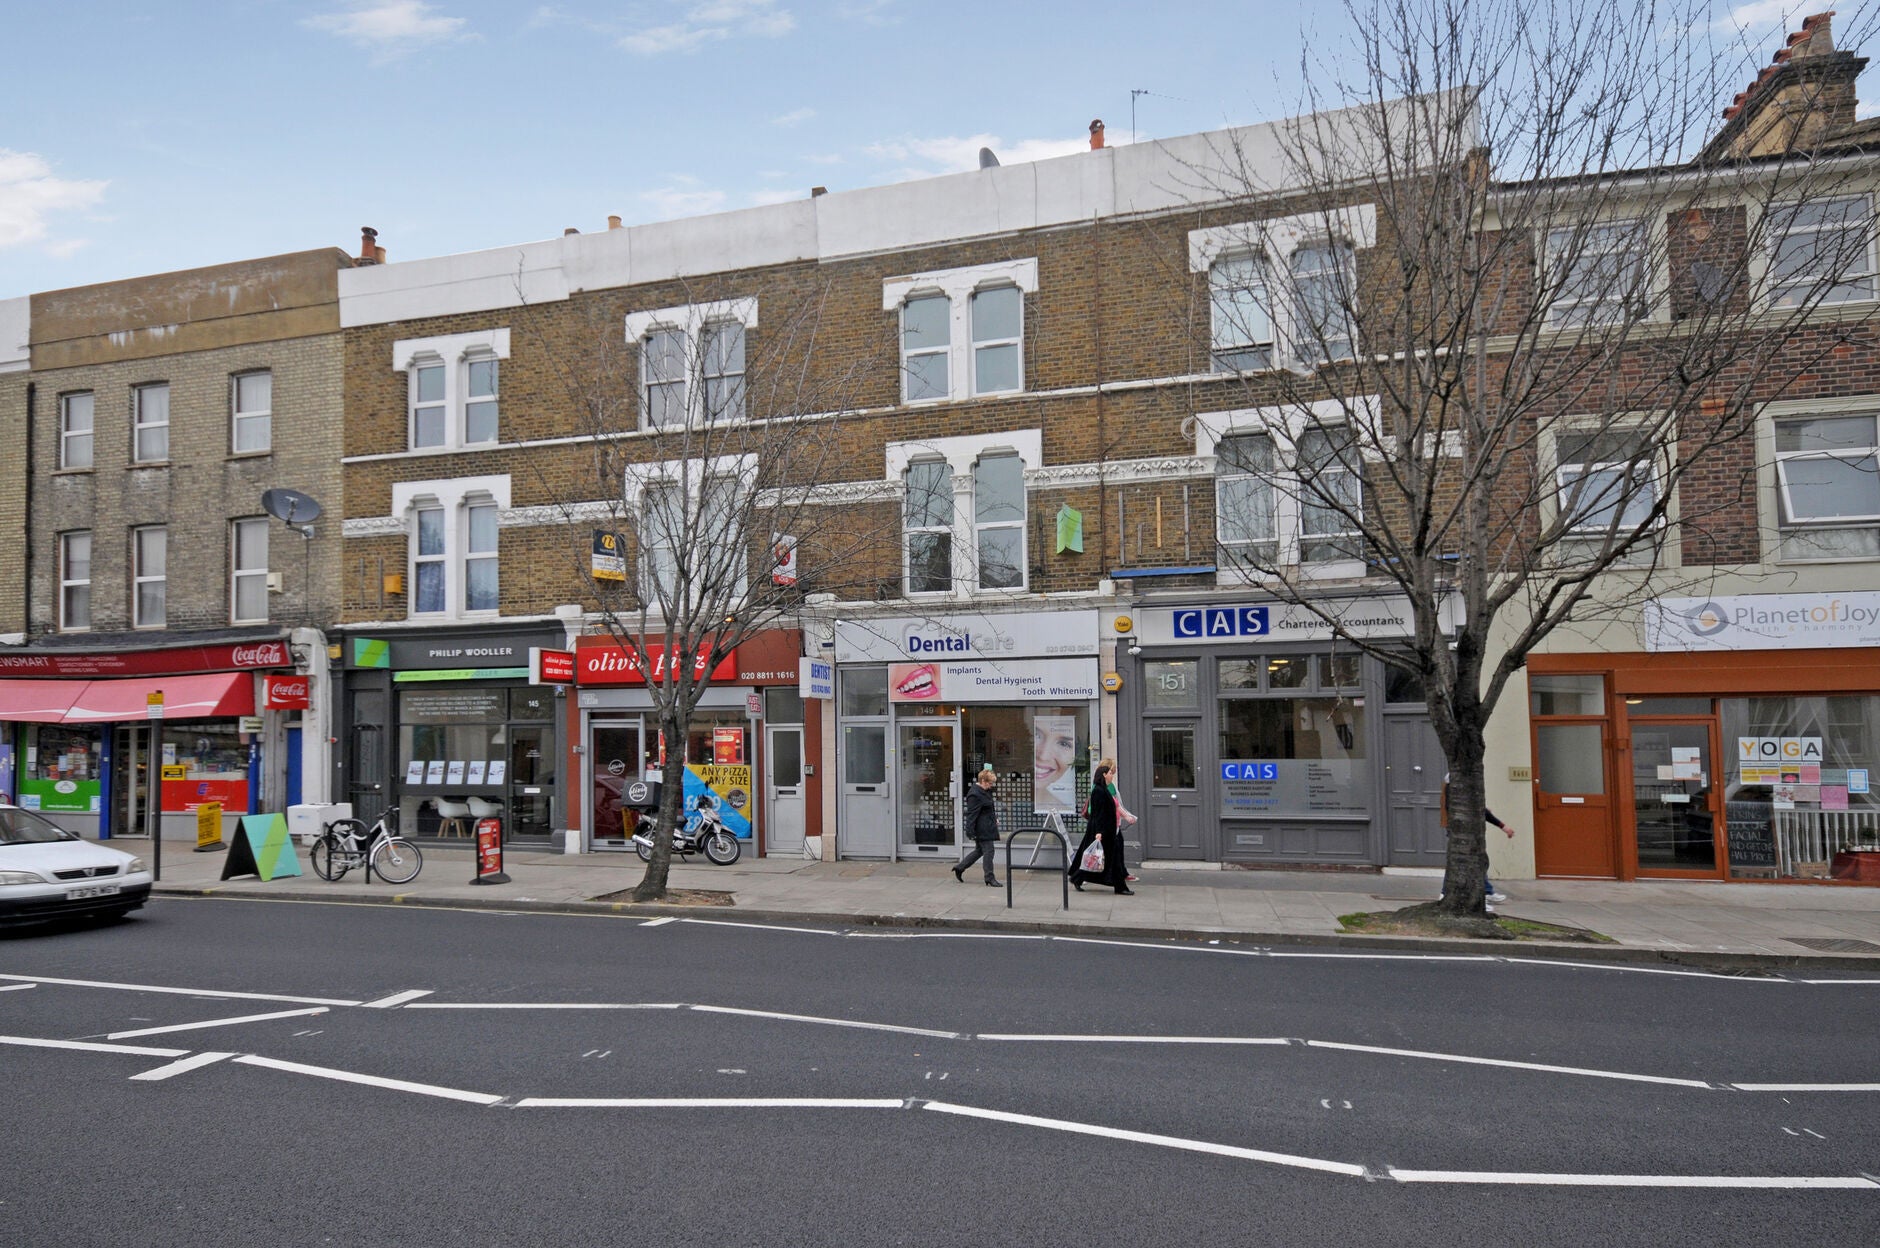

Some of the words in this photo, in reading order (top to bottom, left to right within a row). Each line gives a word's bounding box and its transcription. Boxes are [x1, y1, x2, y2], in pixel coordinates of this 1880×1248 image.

[1334, 615, 1406, 630] ccountants
[429, 650, 462, 658] PHILIP
[466, 648, 512, 656] WOOLLER
[588, 653, 644, 671] olivi
[741, 673, 756, 681] 020
[757, 672, 774, 680] 8811
[776, 671, 795, 679] 1616
[811, 663, 831, 681] DENTIST
[947, 665, 982, 677] Implants
[976, 677, 1002, 685] Dental
[1004, 674, 1042, 686] Hygienist
[1158, 673, 1185, 690] 151
[1022, 687, 1046, 696] Tooth
[1050, 685, 1093, 697] Whitening
[921, 706, 933, 714] 149
[1741, 742, 1820, 756] YOGA
[701, 768, 720, 776] ANY
[723, 768, 748, 776] PIZZA
[708, 777, 725, 786] ANY
[729, 777, 748, 786] SIZE
[1730, 831, 1767, 841] FACIAL
